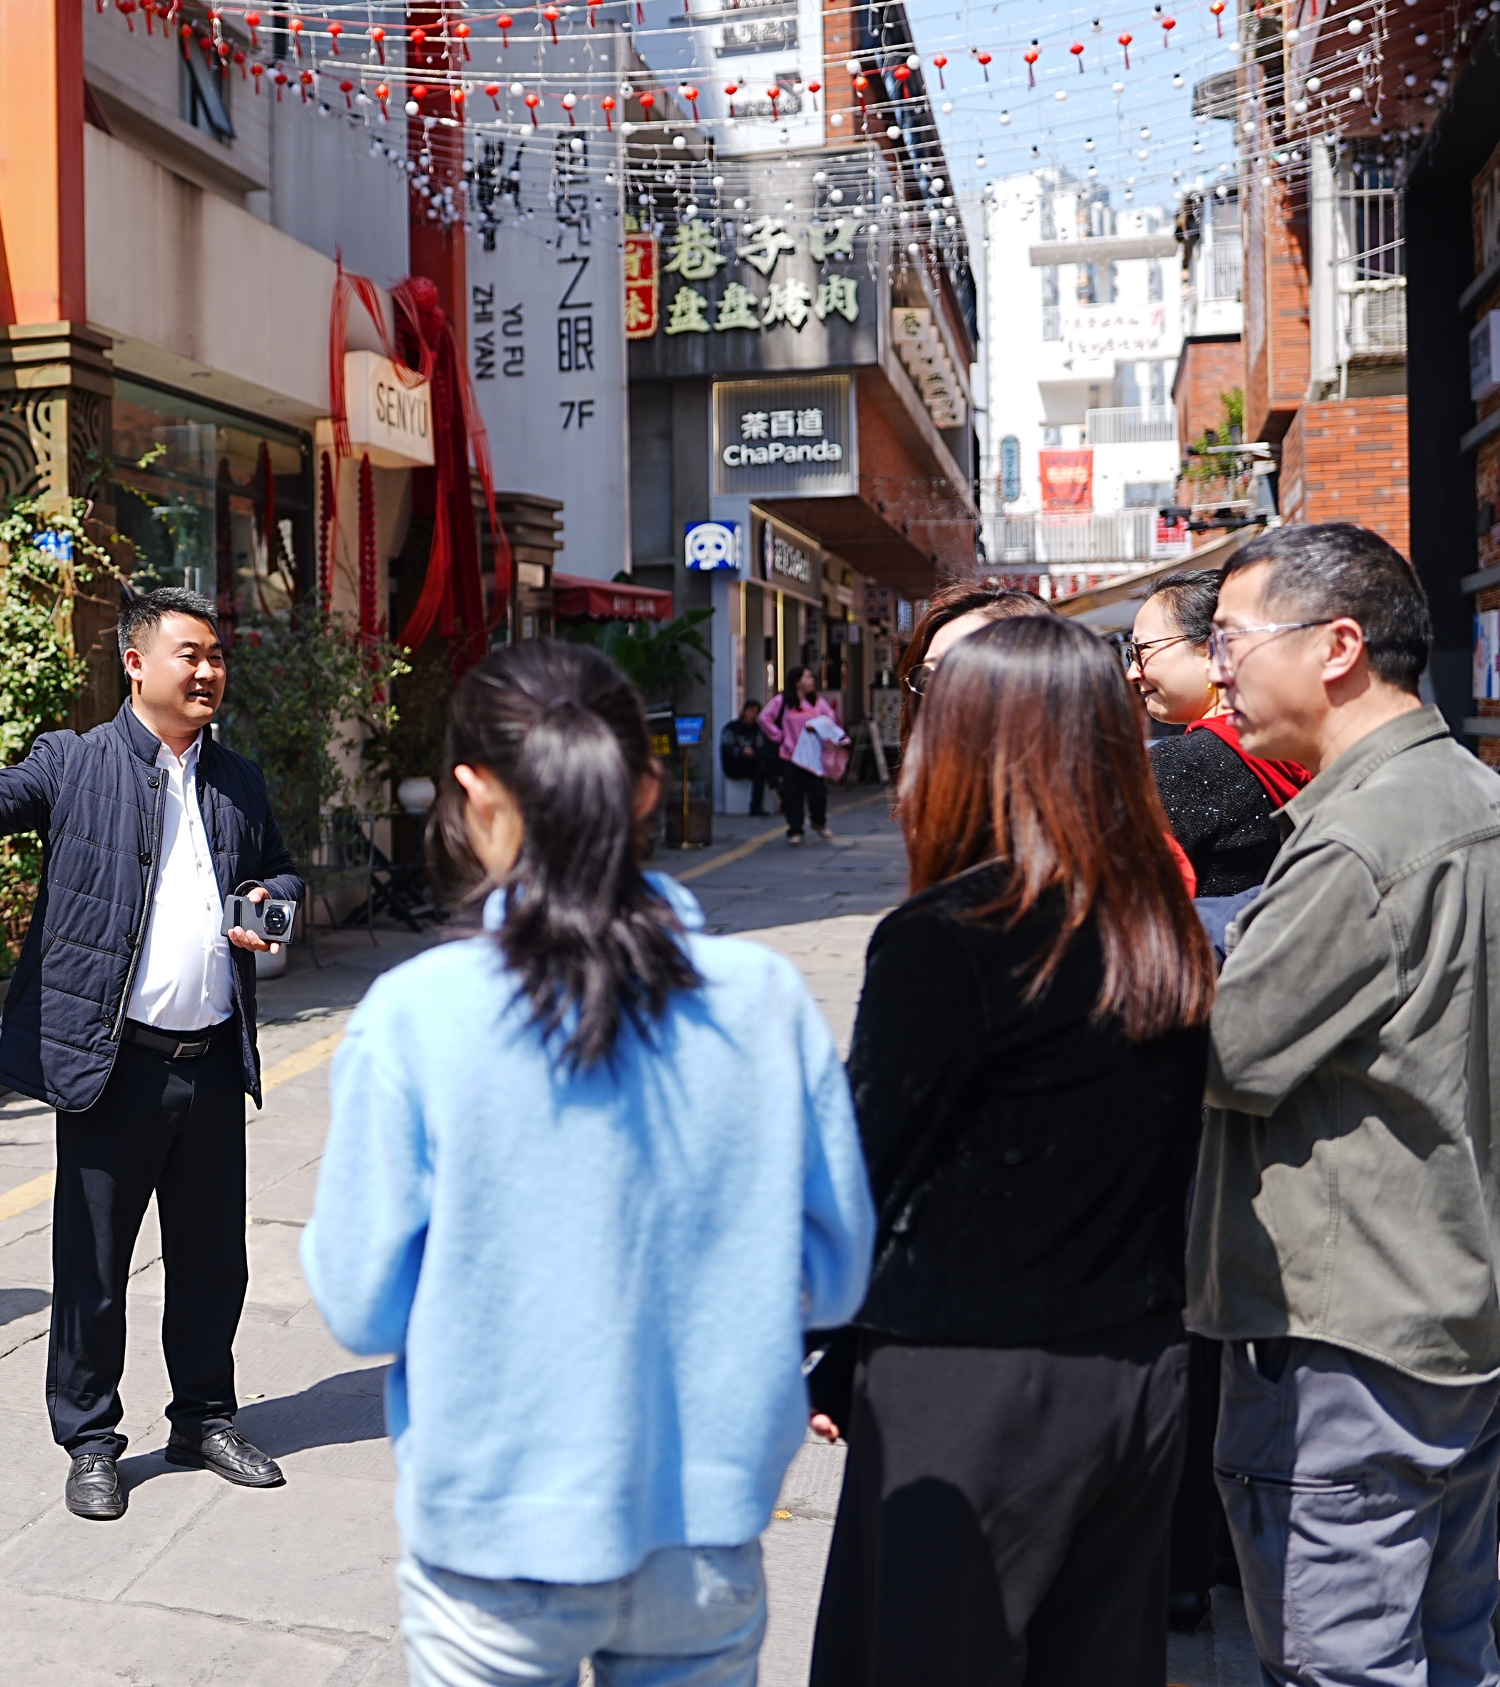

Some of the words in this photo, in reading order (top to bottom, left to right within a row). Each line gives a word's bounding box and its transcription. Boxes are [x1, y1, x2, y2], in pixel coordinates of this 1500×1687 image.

[662, 215, 861, 280] 巷子口
[473, 283, 494, 323] ZHI
[502, 302, 523, 337] YU
[664, 274, 860, 335] 盘盘烤肉
[474, 330, 495, 380] YAN
[503, 346, 524, 377] FU
[377, 382, 428, 438] SENYU
[559, 399, 594, 430] 7F
[741, 408, 824, 440] 茶百道
[723, 439, 842, 466] ChaPanda
